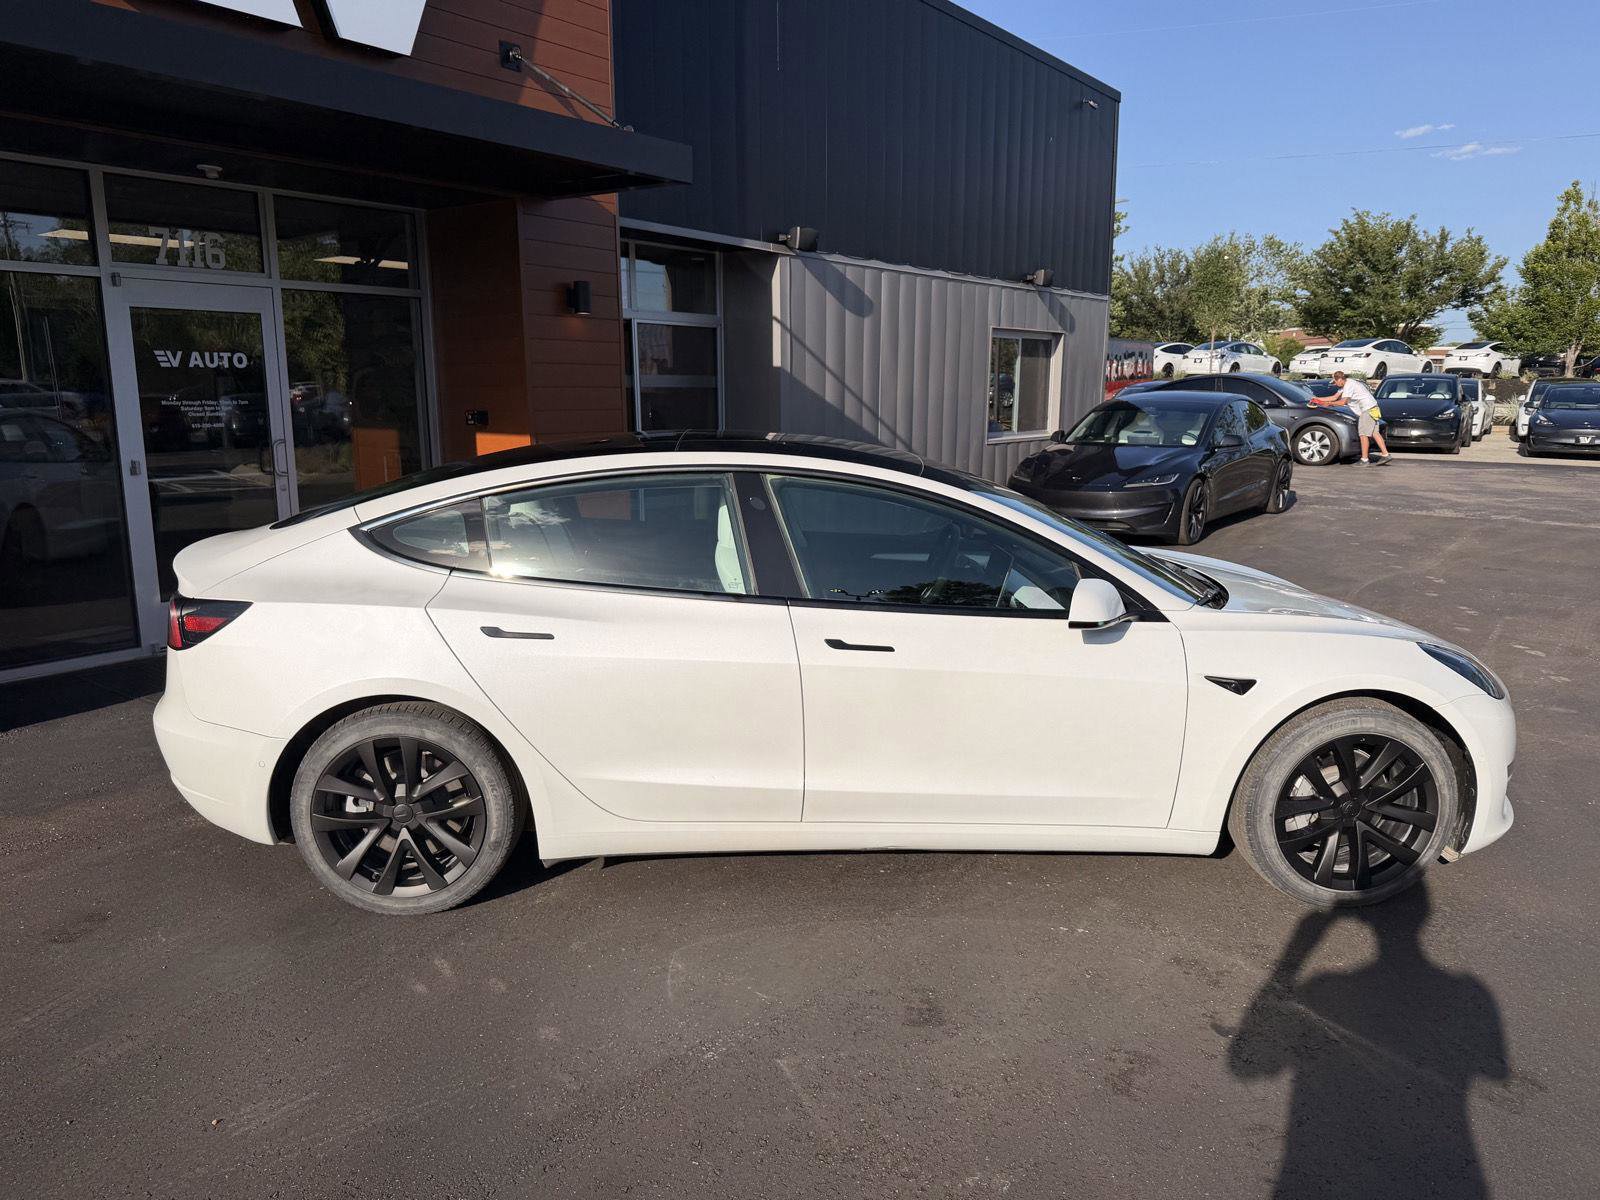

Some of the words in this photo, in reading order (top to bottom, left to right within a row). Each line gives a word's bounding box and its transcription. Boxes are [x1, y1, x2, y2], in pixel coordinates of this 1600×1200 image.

[149, 226, 226, 269] 7116
[153, 350, 183, 367] EV
[189, 351, 248, 368] AUTO
